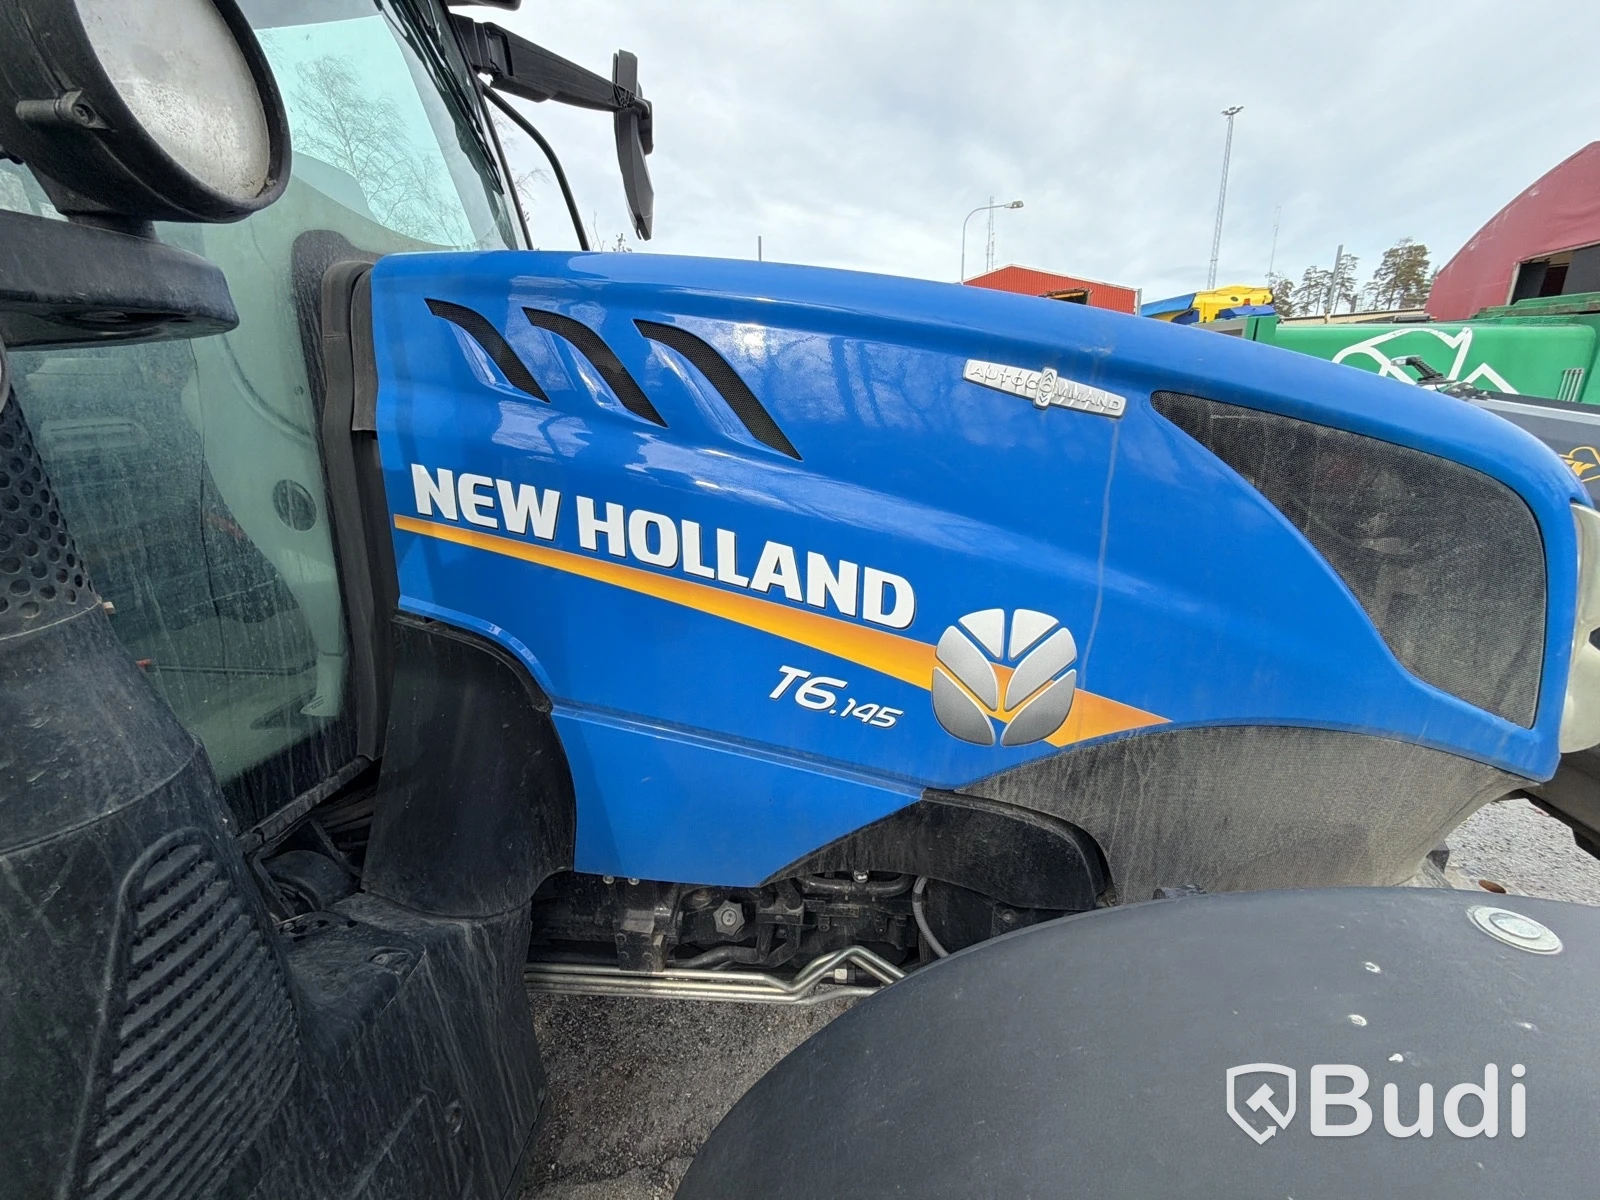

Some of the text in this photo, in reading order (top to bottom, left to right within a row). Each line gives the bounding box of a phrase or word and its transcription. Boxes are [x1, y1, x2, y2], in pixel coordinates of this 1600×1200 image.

[411, 464, 916, 629] NEW HOLLAND
[768, 664, 903, 728] T6.145
